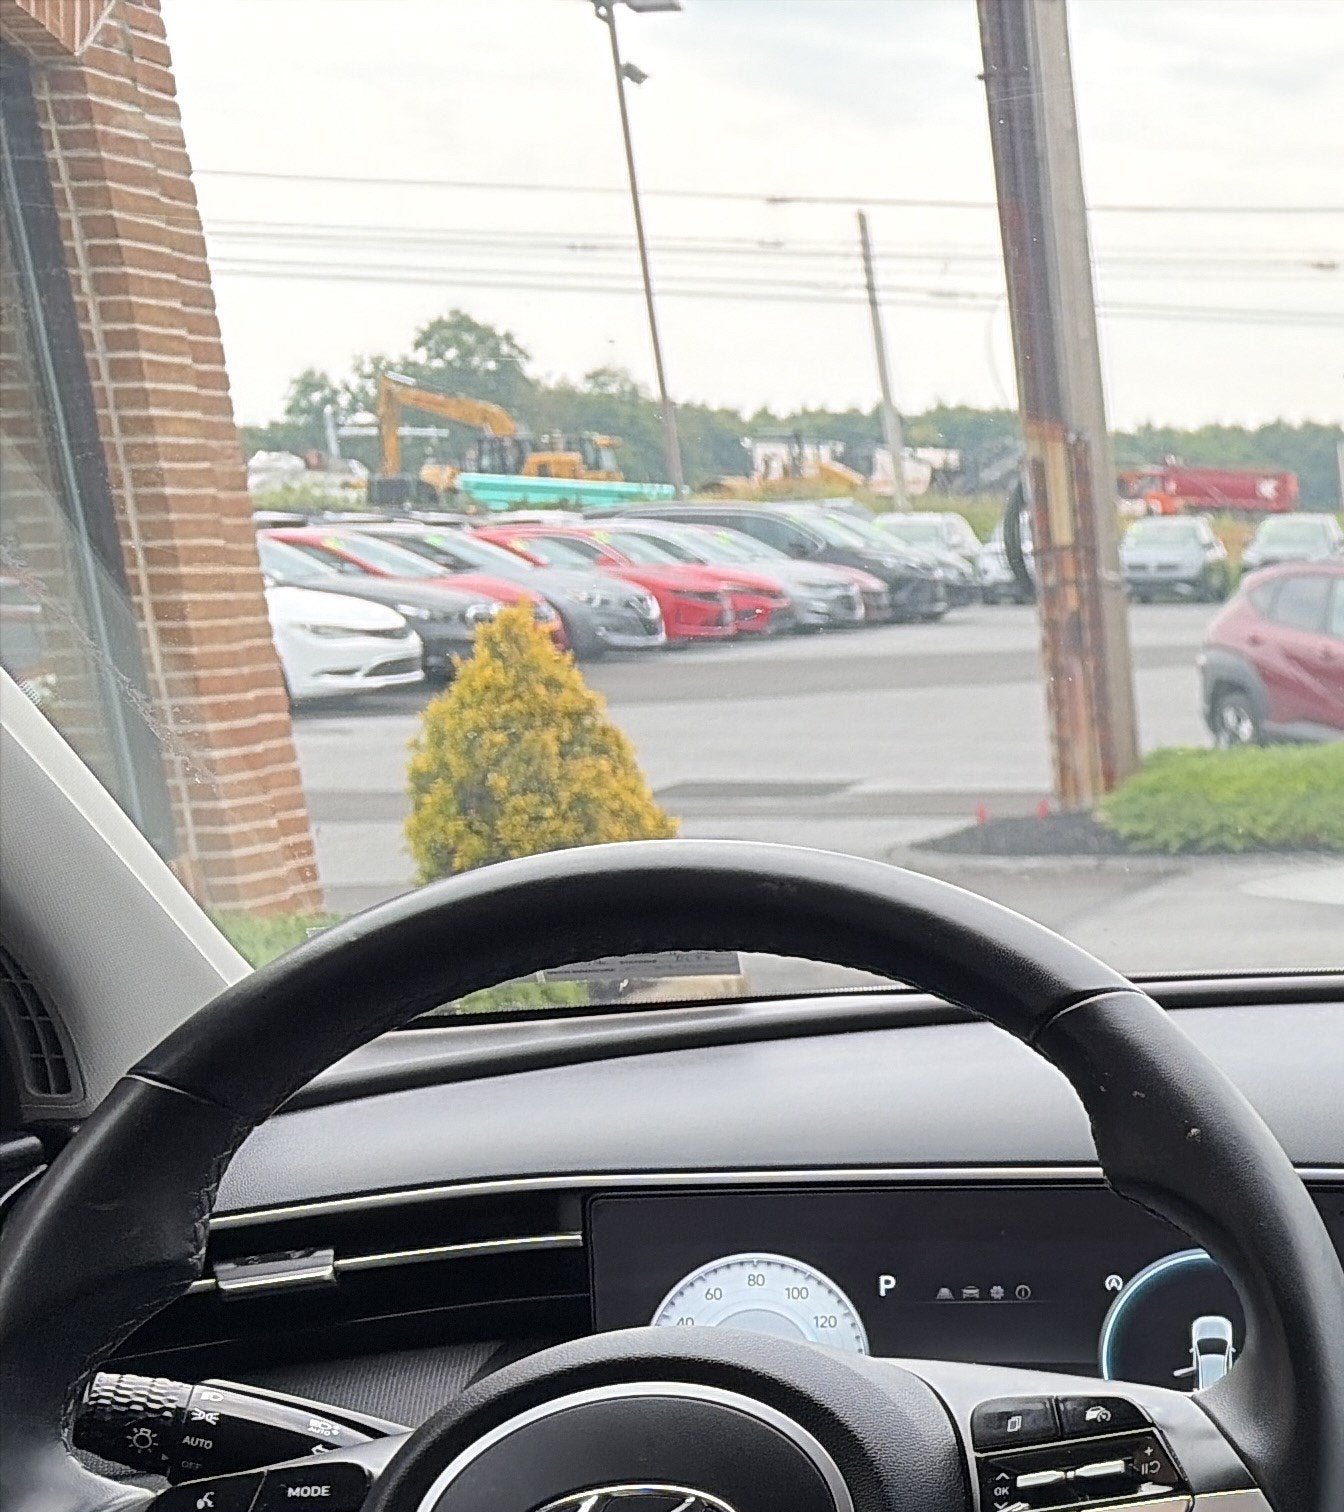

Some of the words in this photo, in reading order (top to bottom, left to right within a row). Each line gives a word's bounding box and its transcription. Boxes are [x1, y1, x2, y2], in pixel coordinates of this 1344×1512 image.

[747, 1273, 765, 1287] 80
[878, 1274, 896, 1297] P
[704, 1286, 723, 1301] 60
[784, 1286, 809, 1300] 100
[813, 1315, 838, 1328] 120
[182, 1435, 213, 1450] AUTO
[287, 1485, 331, 1498] MODE
[993, 1486, 1010, 1497] OK
